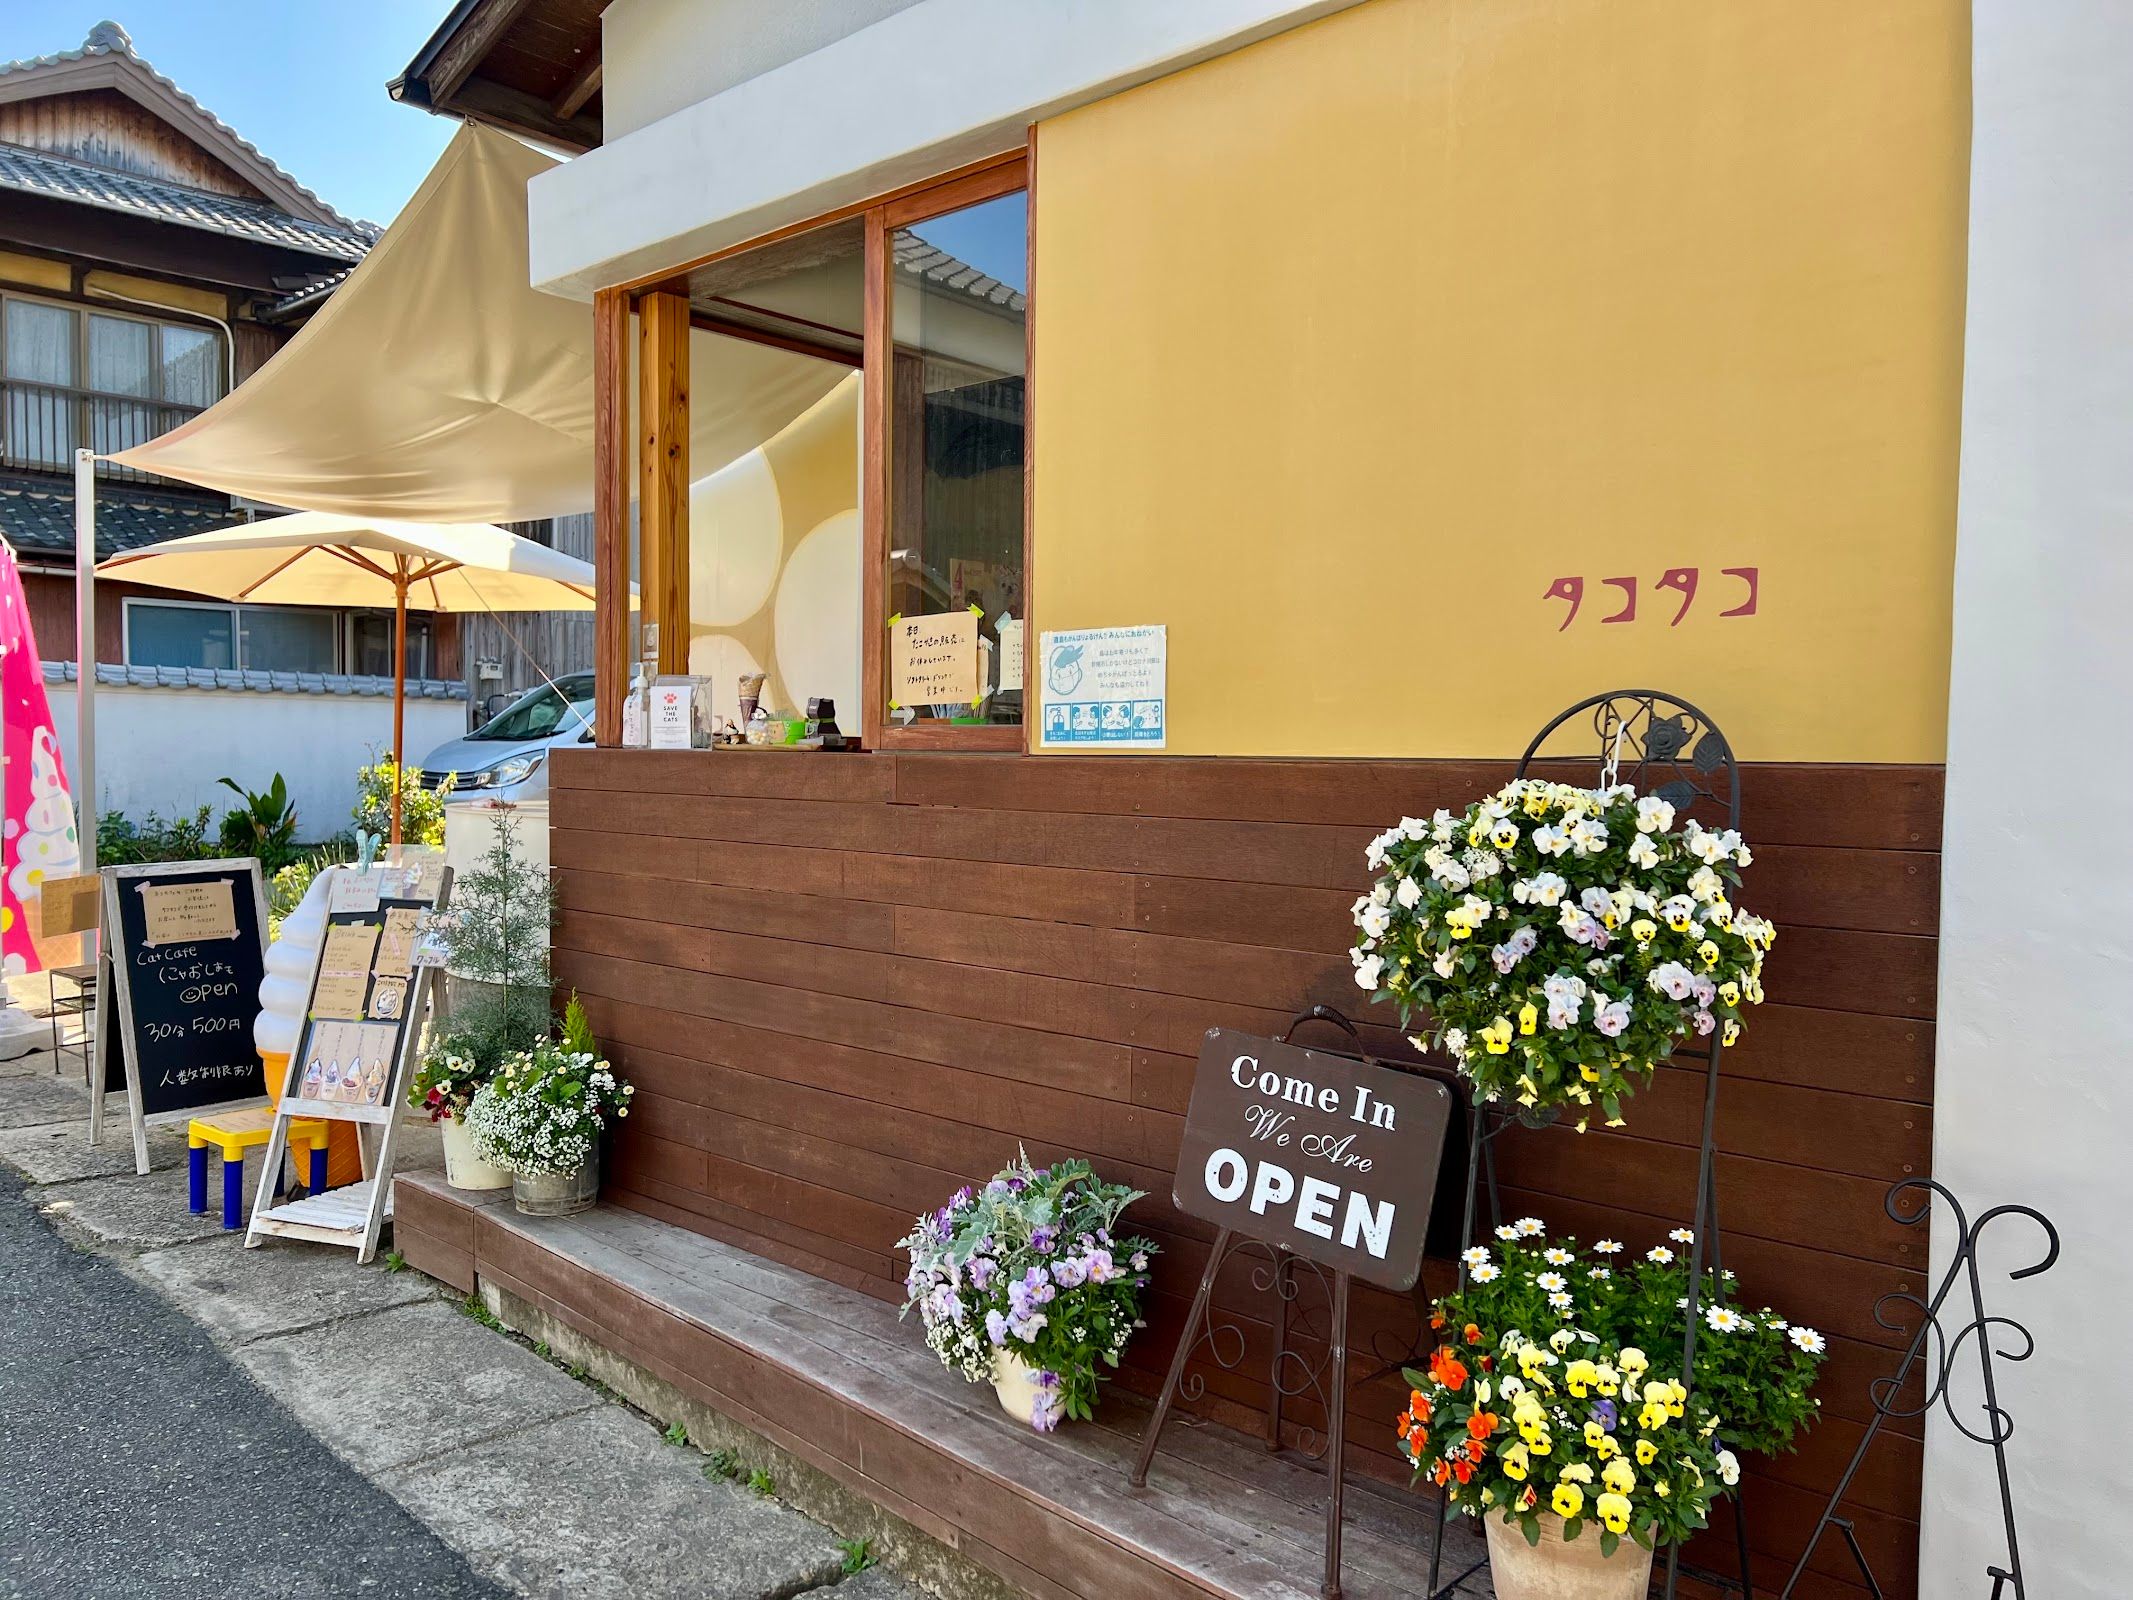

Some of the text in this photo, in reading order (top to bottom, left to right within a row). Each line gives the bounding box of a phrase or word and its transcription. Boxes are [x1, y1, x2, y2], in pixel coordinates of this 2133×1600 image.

[1542, 567, 1759, 633] タコタコ
[906, 625, 919, 637] 本日
[137, 945, 197, 966] Cat Cafe
[144, 1016, 241, 1042] 30分 500円
[160, 1064, 254, 1088] 人数制限あり
[1230, 1055, 1396, 1131] Come In
[1244, 1104, 1373, 1173] We Are
[1204, 1148, 1396, 1260] OPEN
